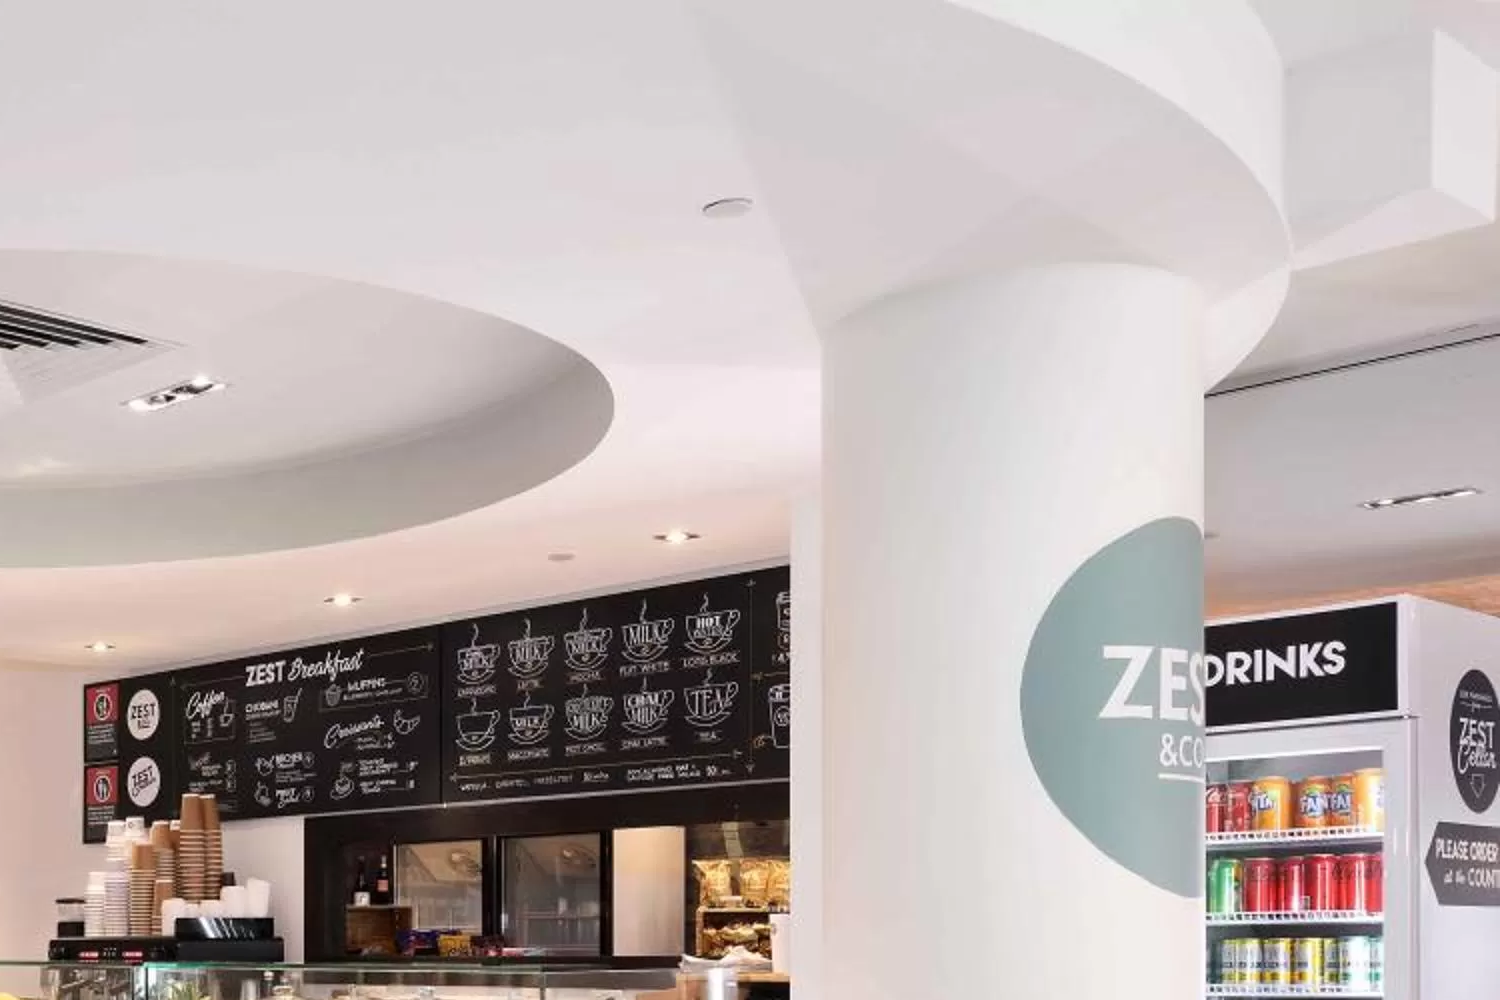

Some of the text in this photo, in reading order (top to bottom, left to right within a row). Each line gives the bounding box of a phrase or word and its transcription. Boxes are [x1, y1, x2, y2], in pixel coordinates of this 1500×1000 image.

[630, 625, 660, 645] MILK
[245, 648, 364, 687] ZEST Breakfast
[1204, 640, 1346, 688] DRINKS
[131, 703, 156, 720] ZEST
[1460, 717, 1496, 749] ZEST
[1435, 838, 1499, 862] PLEASE ORDER
